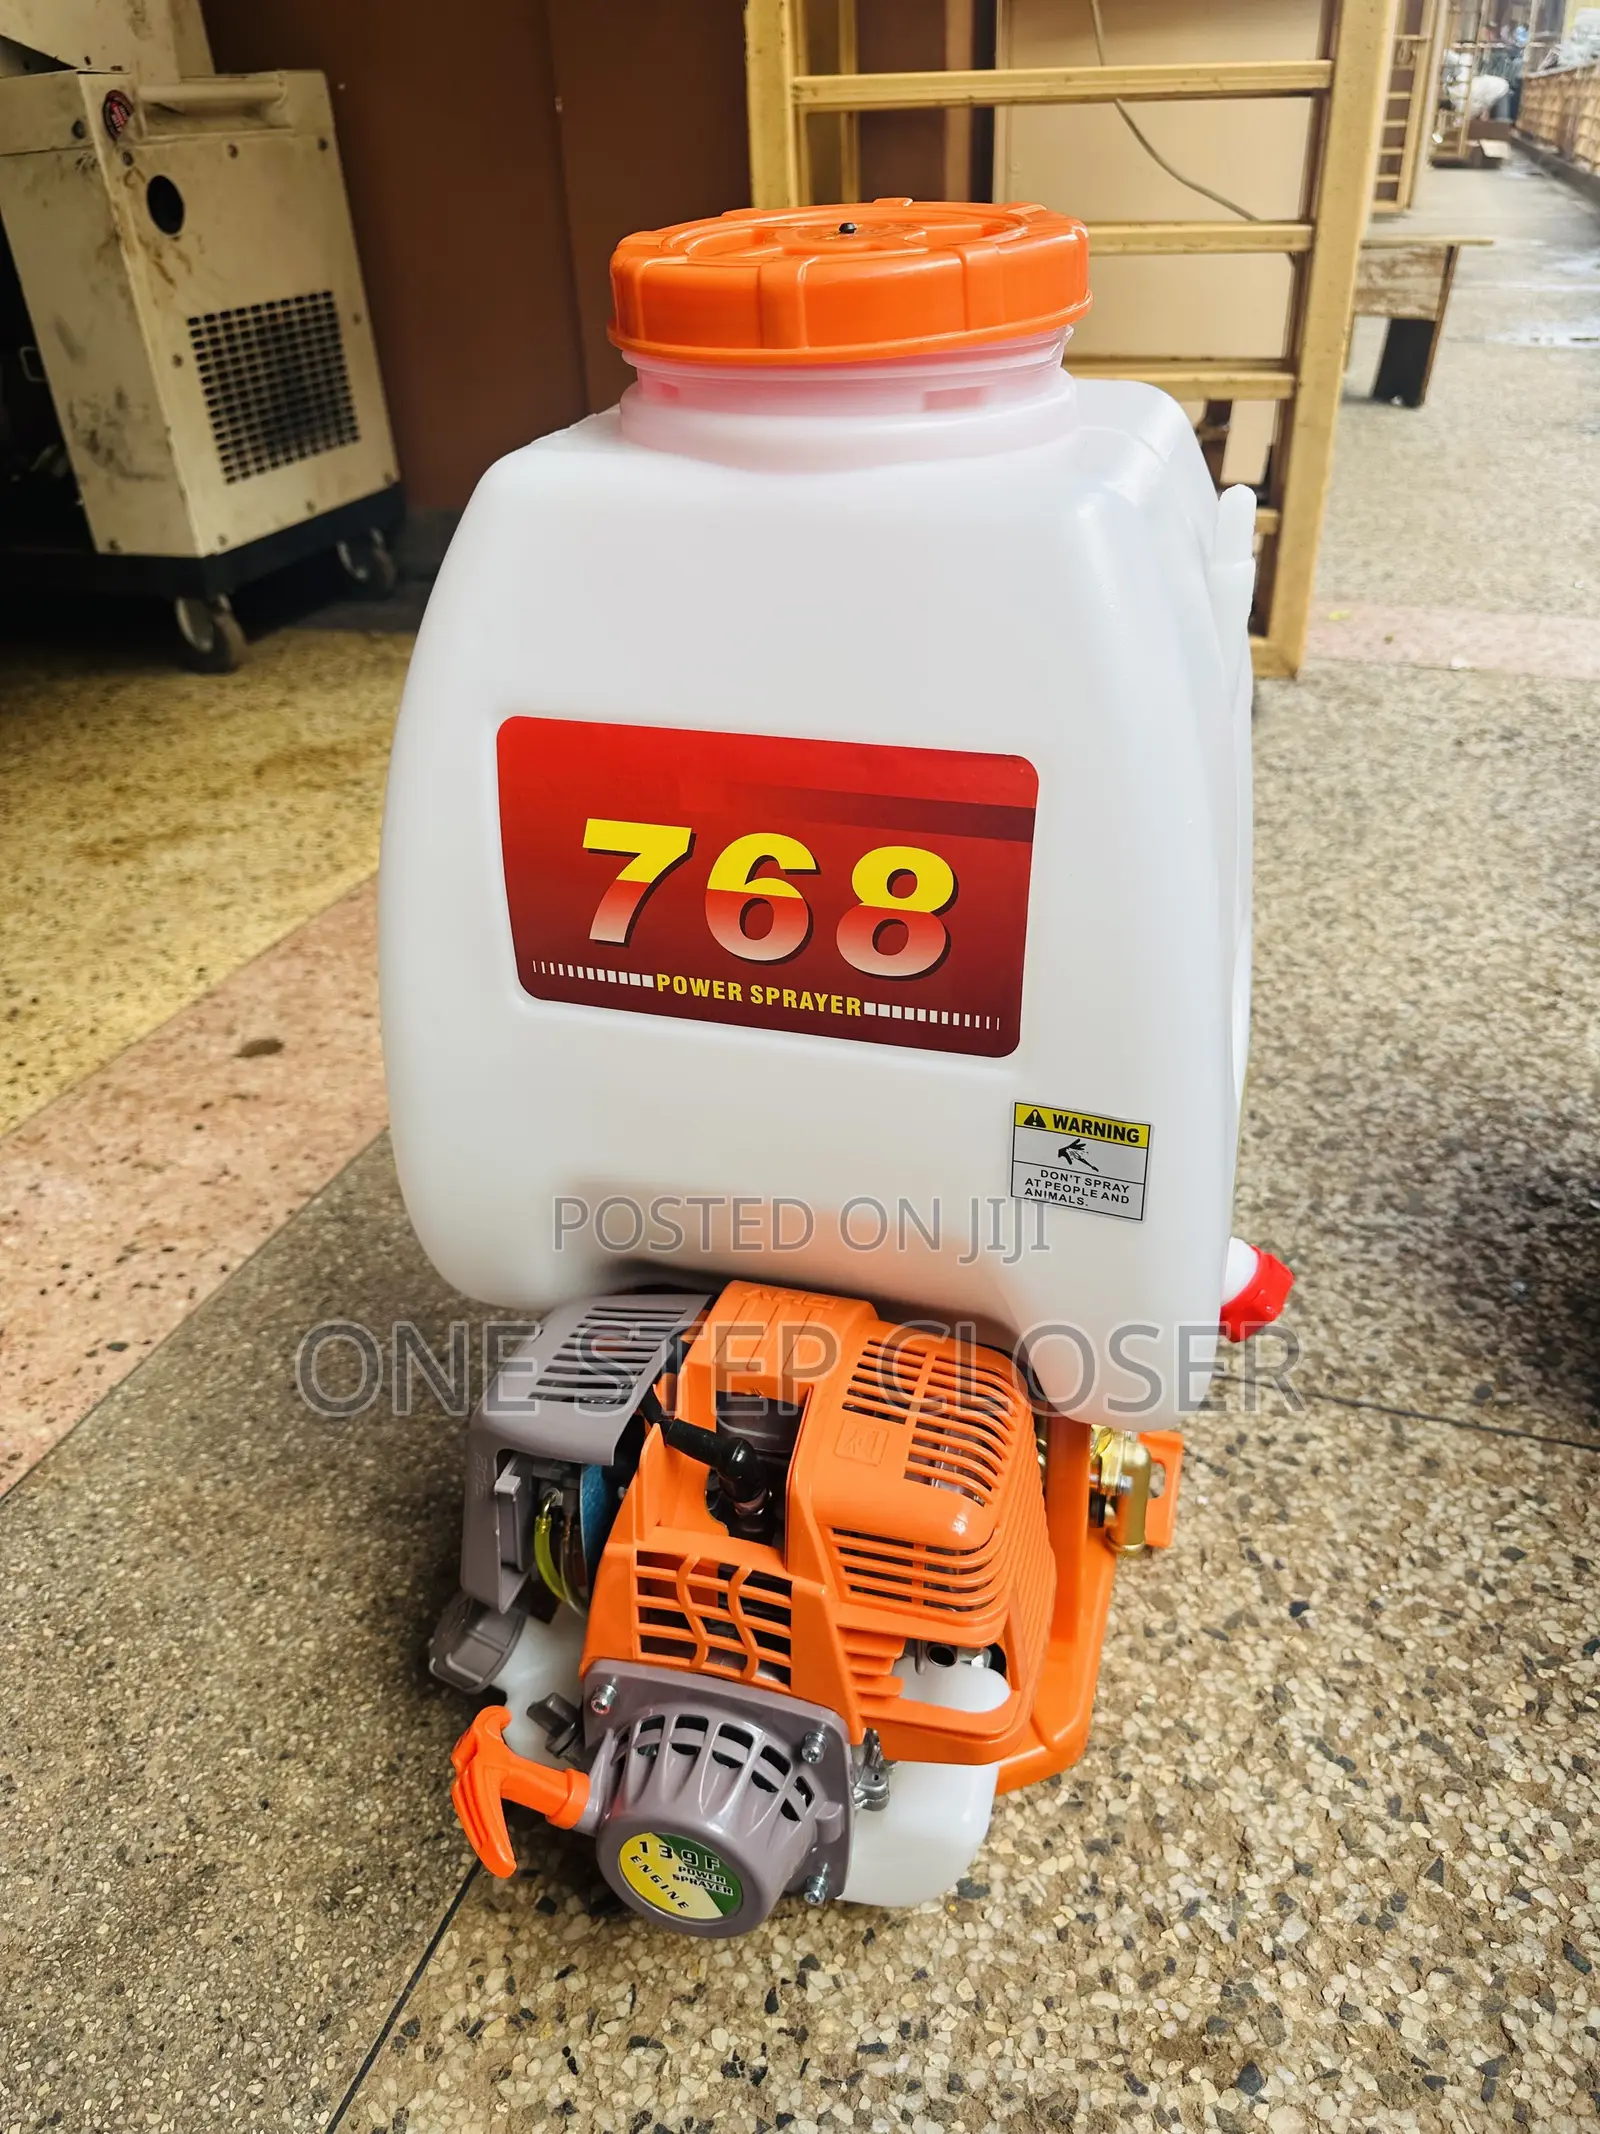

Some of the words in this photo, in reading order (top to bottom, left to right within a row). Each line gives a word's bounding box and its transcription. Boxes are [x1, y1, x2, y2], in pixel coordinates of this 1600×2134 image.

[582, 818, 960, 981] 768
[656, 973, 743, 1001] POWER
[750, 984, 862, 1016] SPRAYER
[1053, 1113, 1140, 1143] WARNING
[1025, 1178, 1041, 1187] AT
[1045, 1181, 1097, 1198] PEOPLE
[1101, 1190, 1130, 1204] AND
[1040, 1169, 1081, 1184] DON'T
[1084, 1177, 1130, 1193] SPRAY
[1024, 1188, 1088, 1206] ANIMALS.
[639, 1841, 720, 1871] 139F
[630, 1855, 689, 1909] ENGINE
[672, 1874, 734, 1896] SPRAYER
[678, 1866, 726, 1885] POWER
